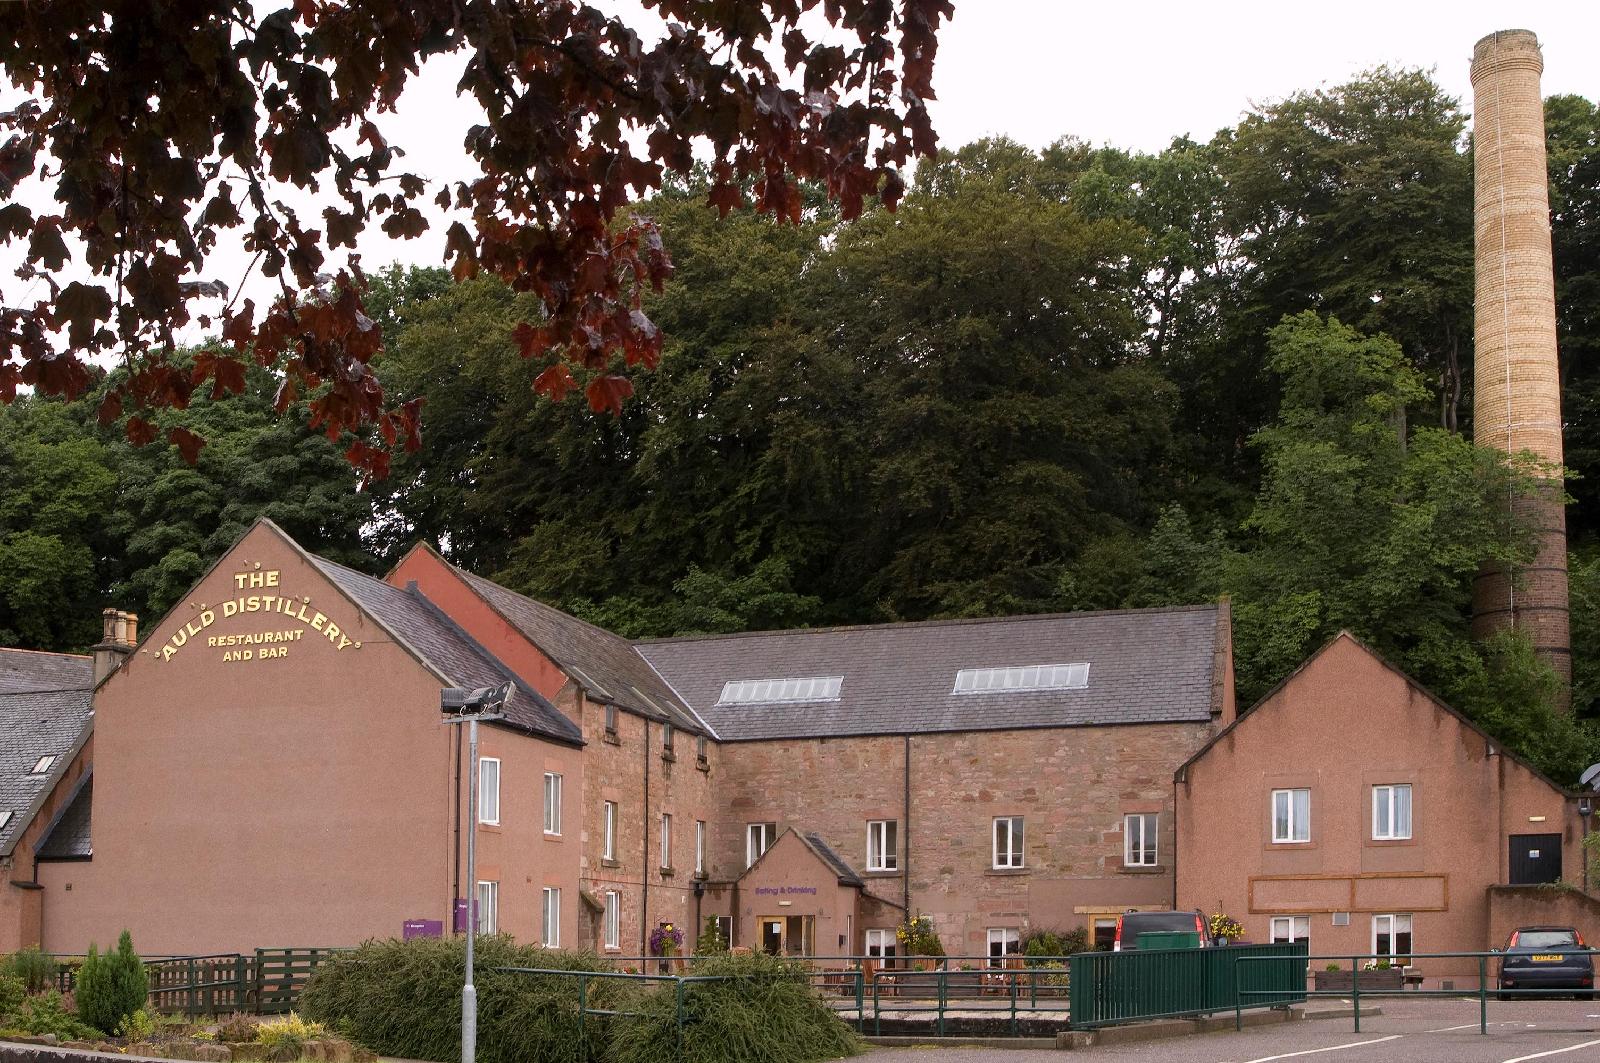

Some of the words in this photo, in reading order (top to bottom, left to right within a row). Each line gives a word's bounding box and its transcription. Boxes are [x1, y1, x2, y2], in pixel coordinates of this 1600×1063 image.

[235, 571, 279, 589] THE
[162, 610, 215, 662] AULD
[222, 596, 353, 651] DISTILLERY
[208, 630, 304, 647] RESTAURANT
[222, 649, 253, 662] AND
[259, 647, 288, 659] BAR
[755, 887, 778, 895] Eating
[787, 887, 816, 895] Drinking
